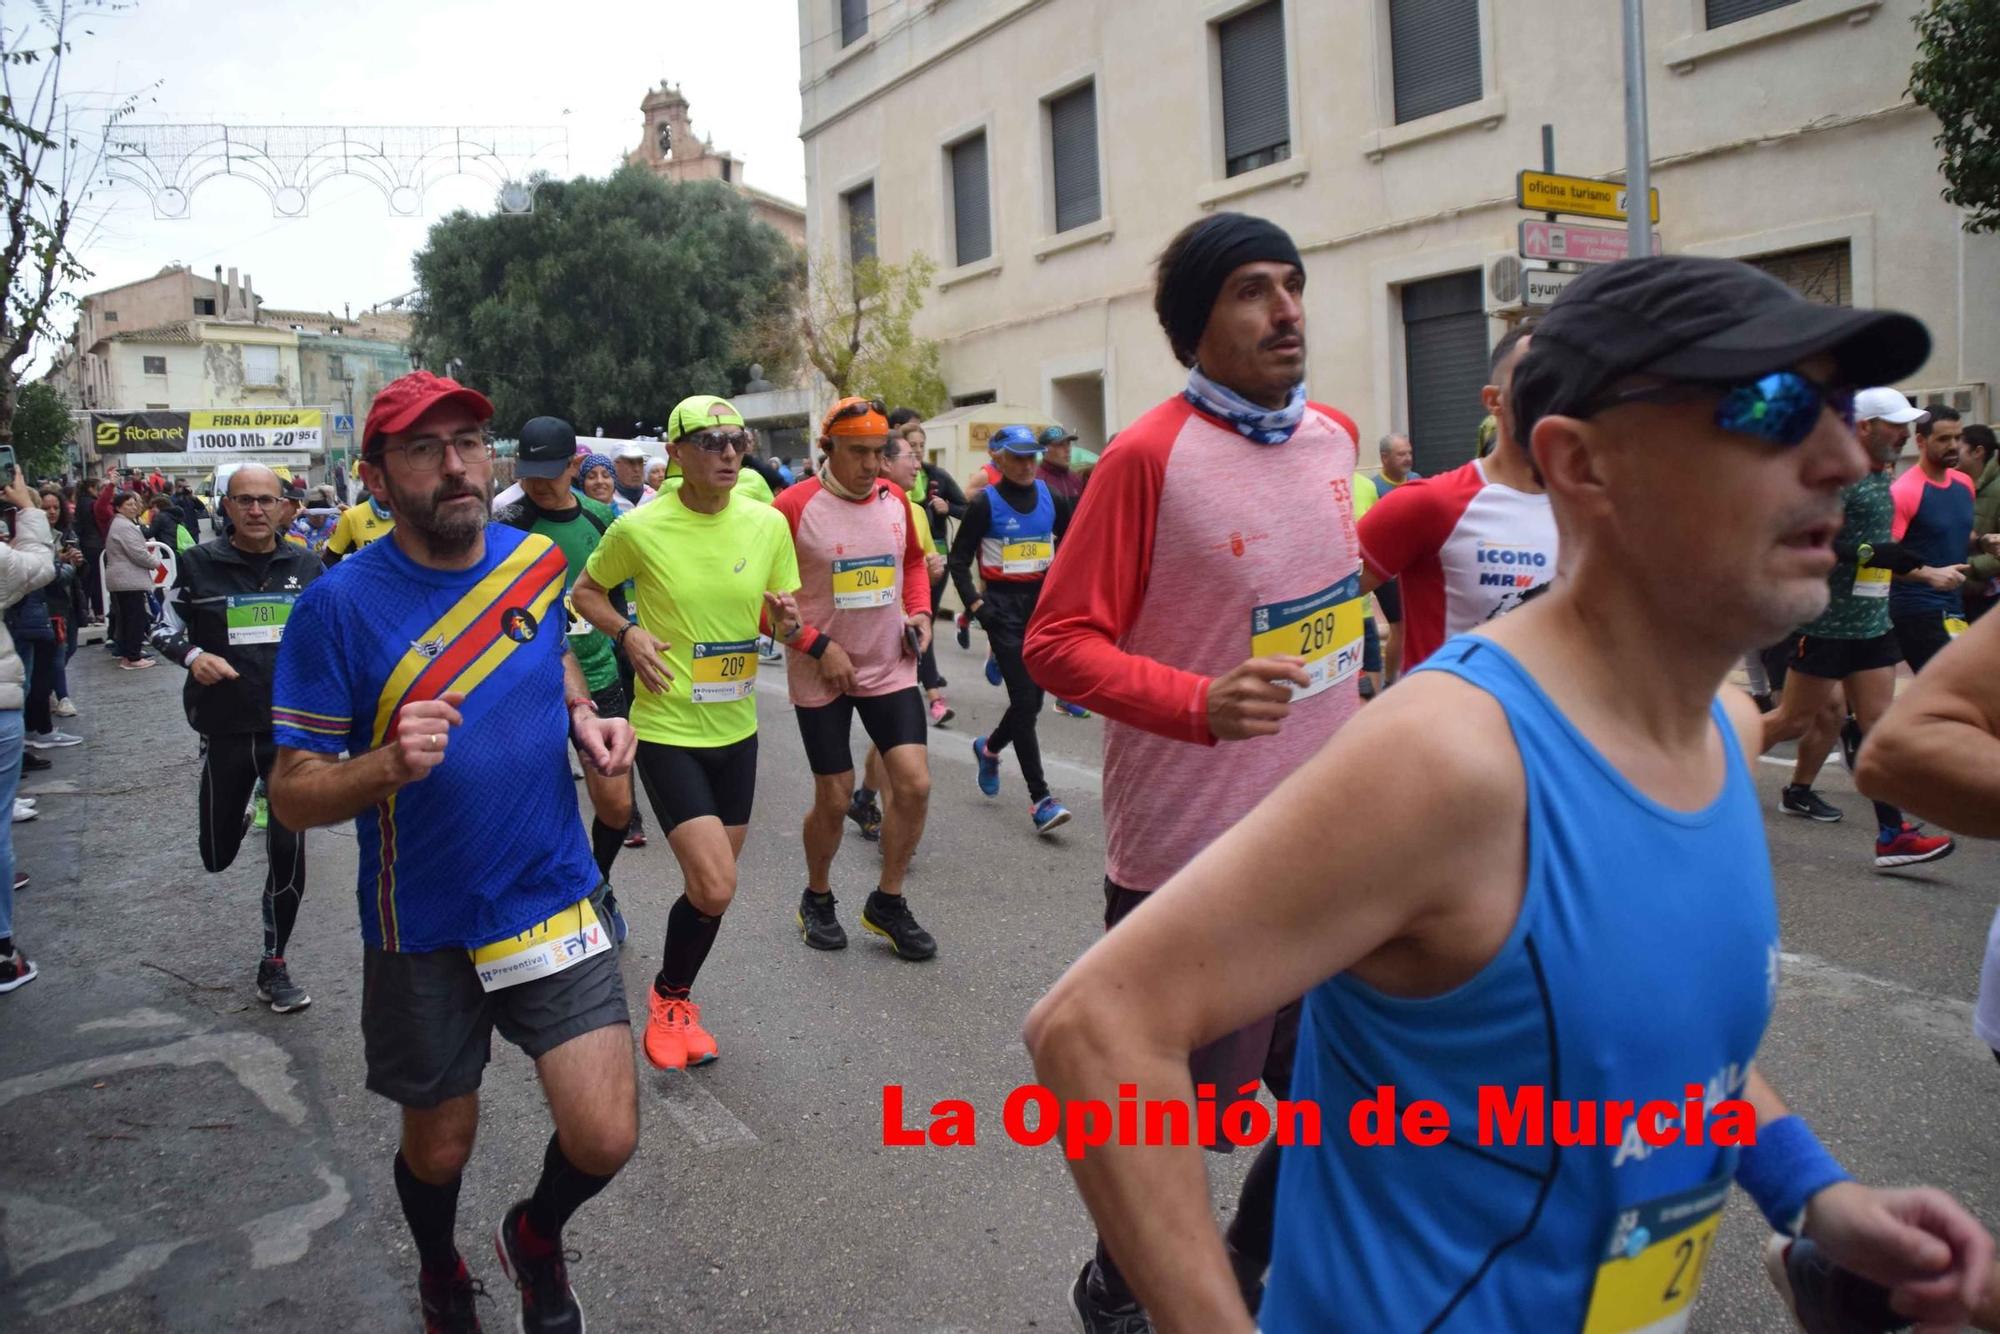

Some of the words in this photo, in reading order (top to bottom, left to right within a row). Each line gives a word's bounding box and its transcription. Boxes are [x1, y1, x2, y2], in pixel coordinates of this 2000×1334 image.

[1528, 180, 1566, 196] oficina
[1571, 184, 1612, 202] turismo
[212, 414, 251, 427] FIBRA
[255, 411, 299, 426] ÓPTICA
[124, 425, 184, 441] fibranet
[198, 433, 237, 448] 1000
[240, 433, 265, 447] Mb
[1020, 544, 1037, 557] 238
[856, 569, 879, 587] 204
[1479, 572, 1535, 588] MRW
[252, 606, 275, 622] 781
[1300, 612, 1335, 655] 289
[721, 656, 745, 677] 209
[491, 956, 544, 976] Preventiva
